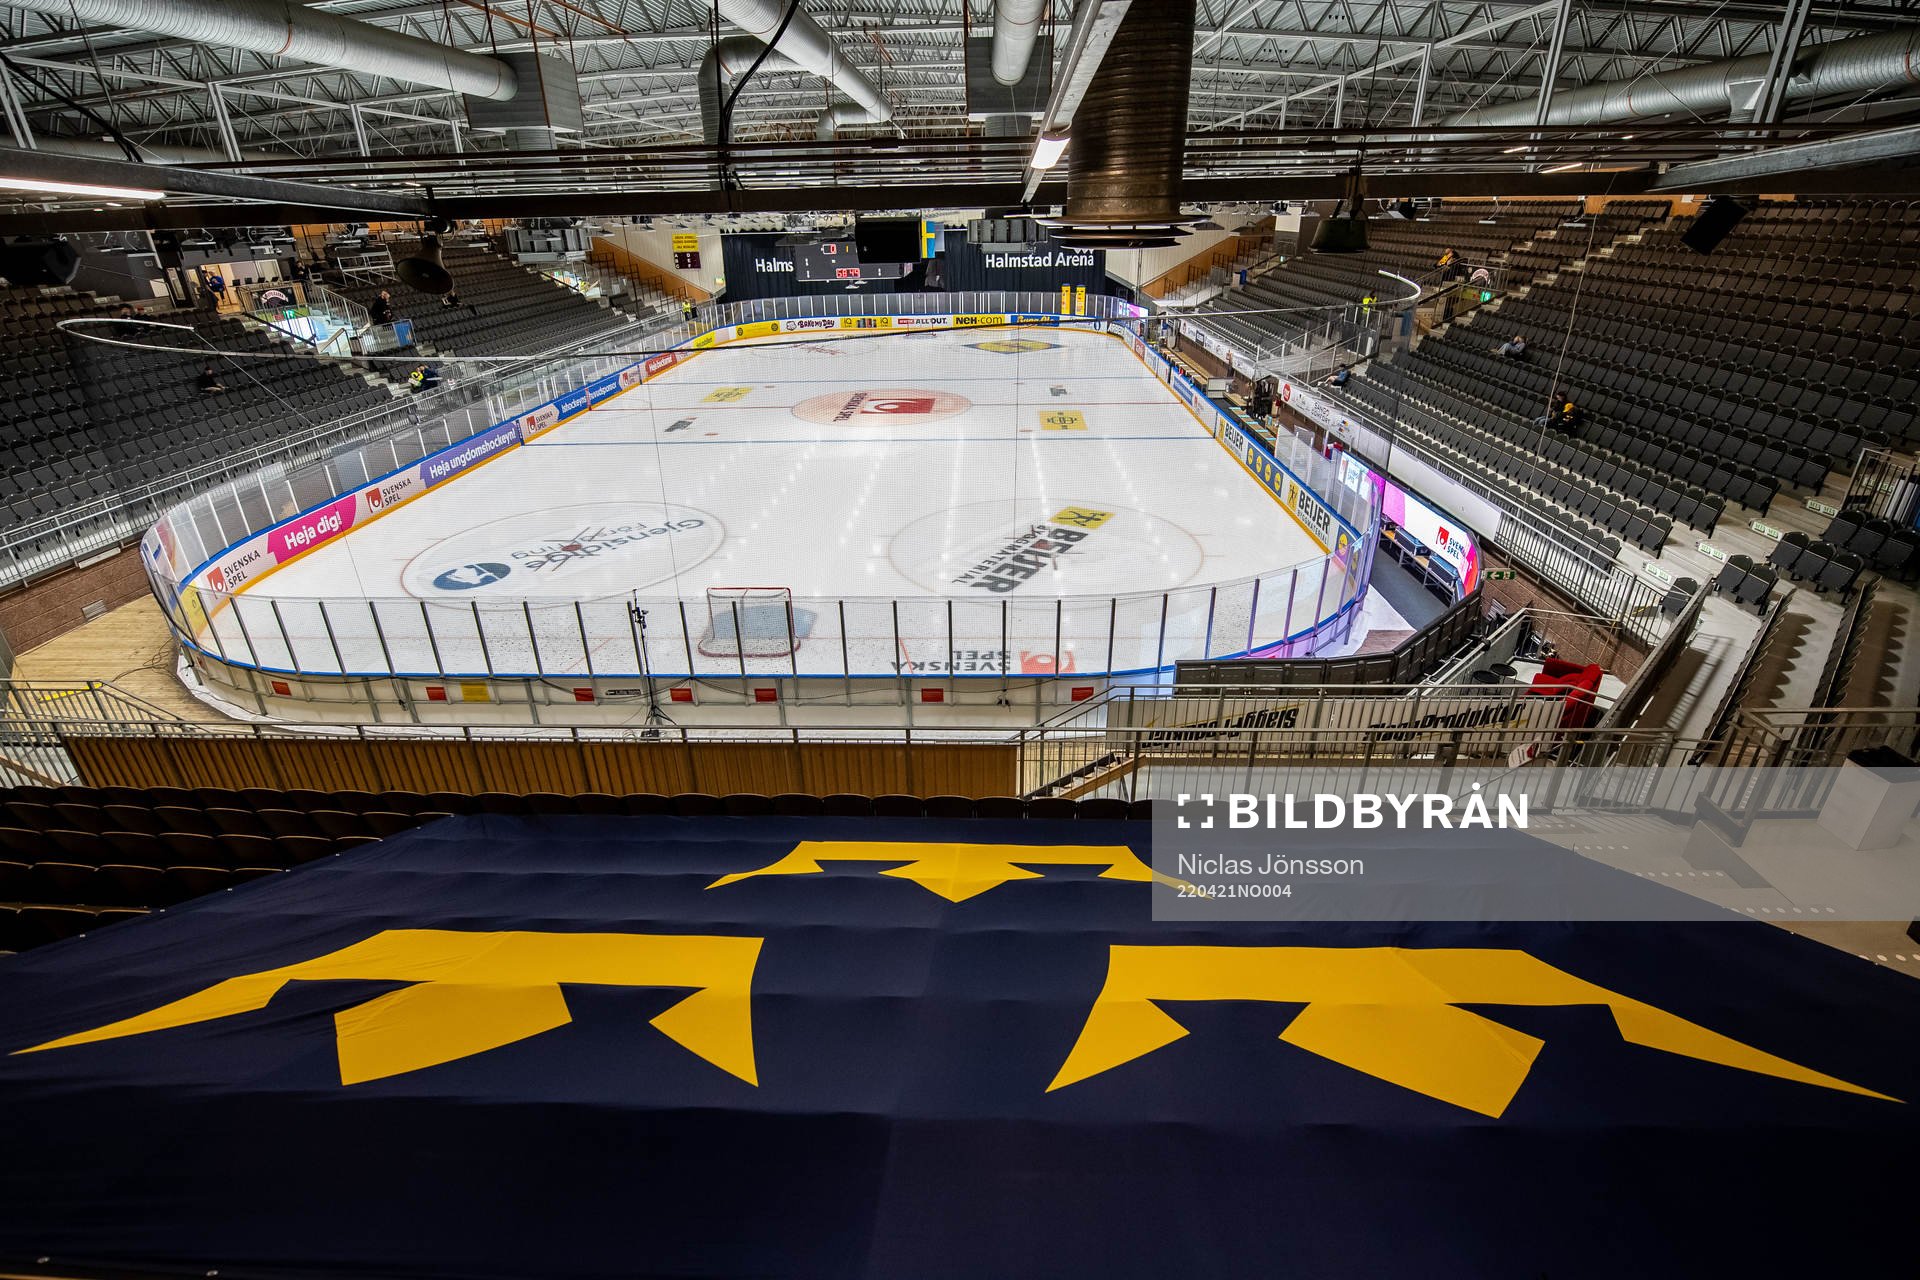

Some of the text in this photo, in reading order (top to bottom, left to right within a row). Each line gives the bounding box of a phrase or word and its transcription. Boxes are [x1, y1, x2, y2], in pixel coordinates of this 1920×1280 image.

[985, 252, 1094, 268] Halmstad Arena
[1225, 423, 1244, 452] BEIJER
[429, 457, 450, 479] Heja
[450, 427, 516, 469] ungdomshockeyn!
[382, 477, 412, 498] SVENSKA
[384, 492, 401, 507] SPEL
[1298, 491, 1331, 536] BEIJER
[284, 511, 343, 551] Heja dig!
[224, 550, 261, 578] SVENSKA
[970, 528, 1088, 593] BEIJER
[1446, 545, 1460, 560] SPEL
[228, 569, 248, 590] SPEL
[953, 651, 1011, 660] SPEL
